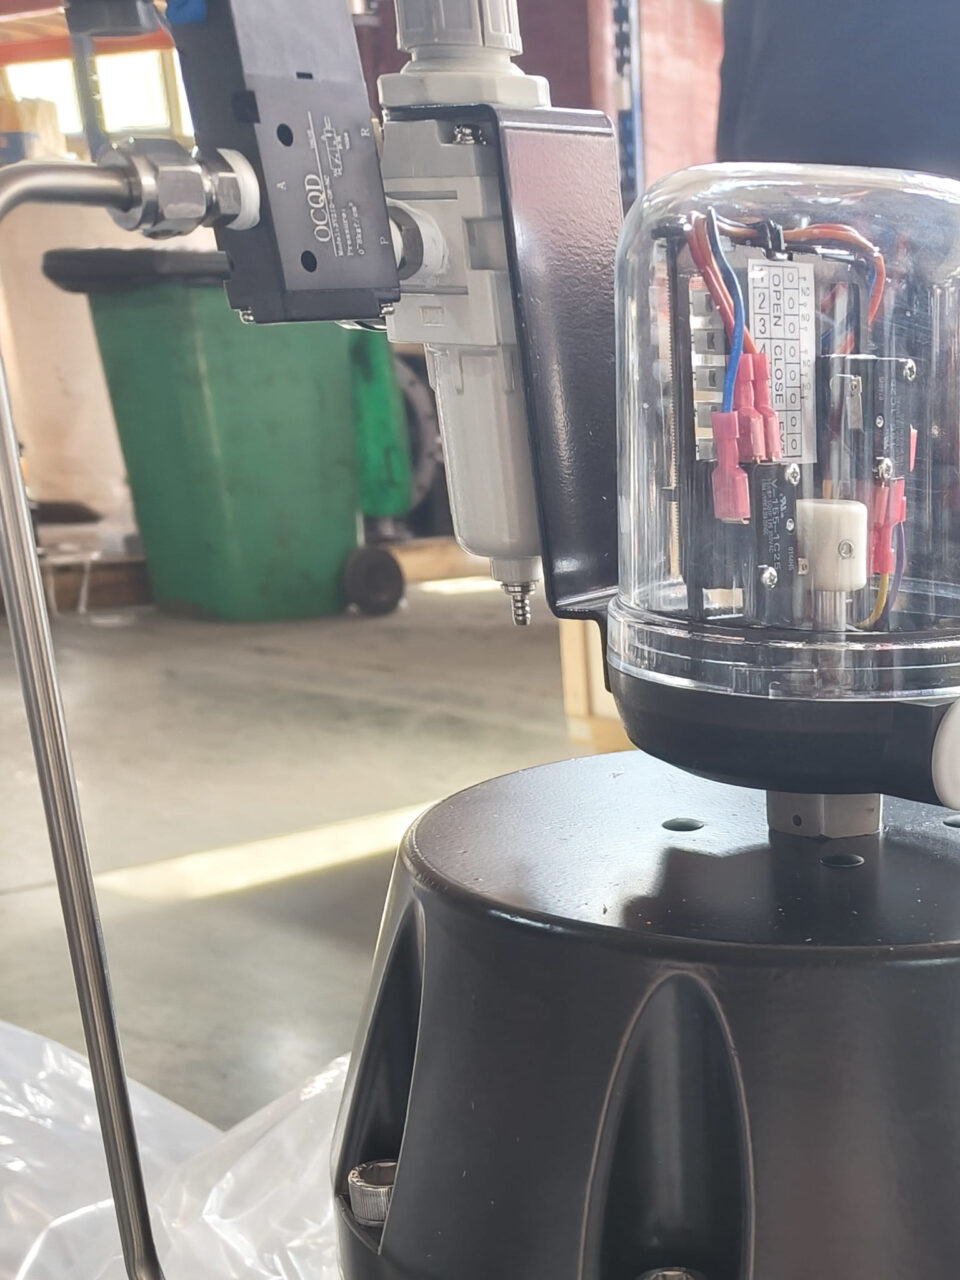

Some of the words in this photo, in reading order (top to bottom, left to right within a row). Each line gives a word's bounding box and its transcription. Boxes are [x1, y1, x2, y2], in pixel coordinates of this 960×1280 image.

[361, 128, 370, 137] R
[276, 181, 286, 190] A
[304, 174, 331, 242] OCQD
[380, 236, 389, 245] P
[758, 292, 766, 310] 2
[772, 273, 782, 327] OPEN
[759, 317, 767, 335] 3
[773, 345, 784, 404] CLOSE
